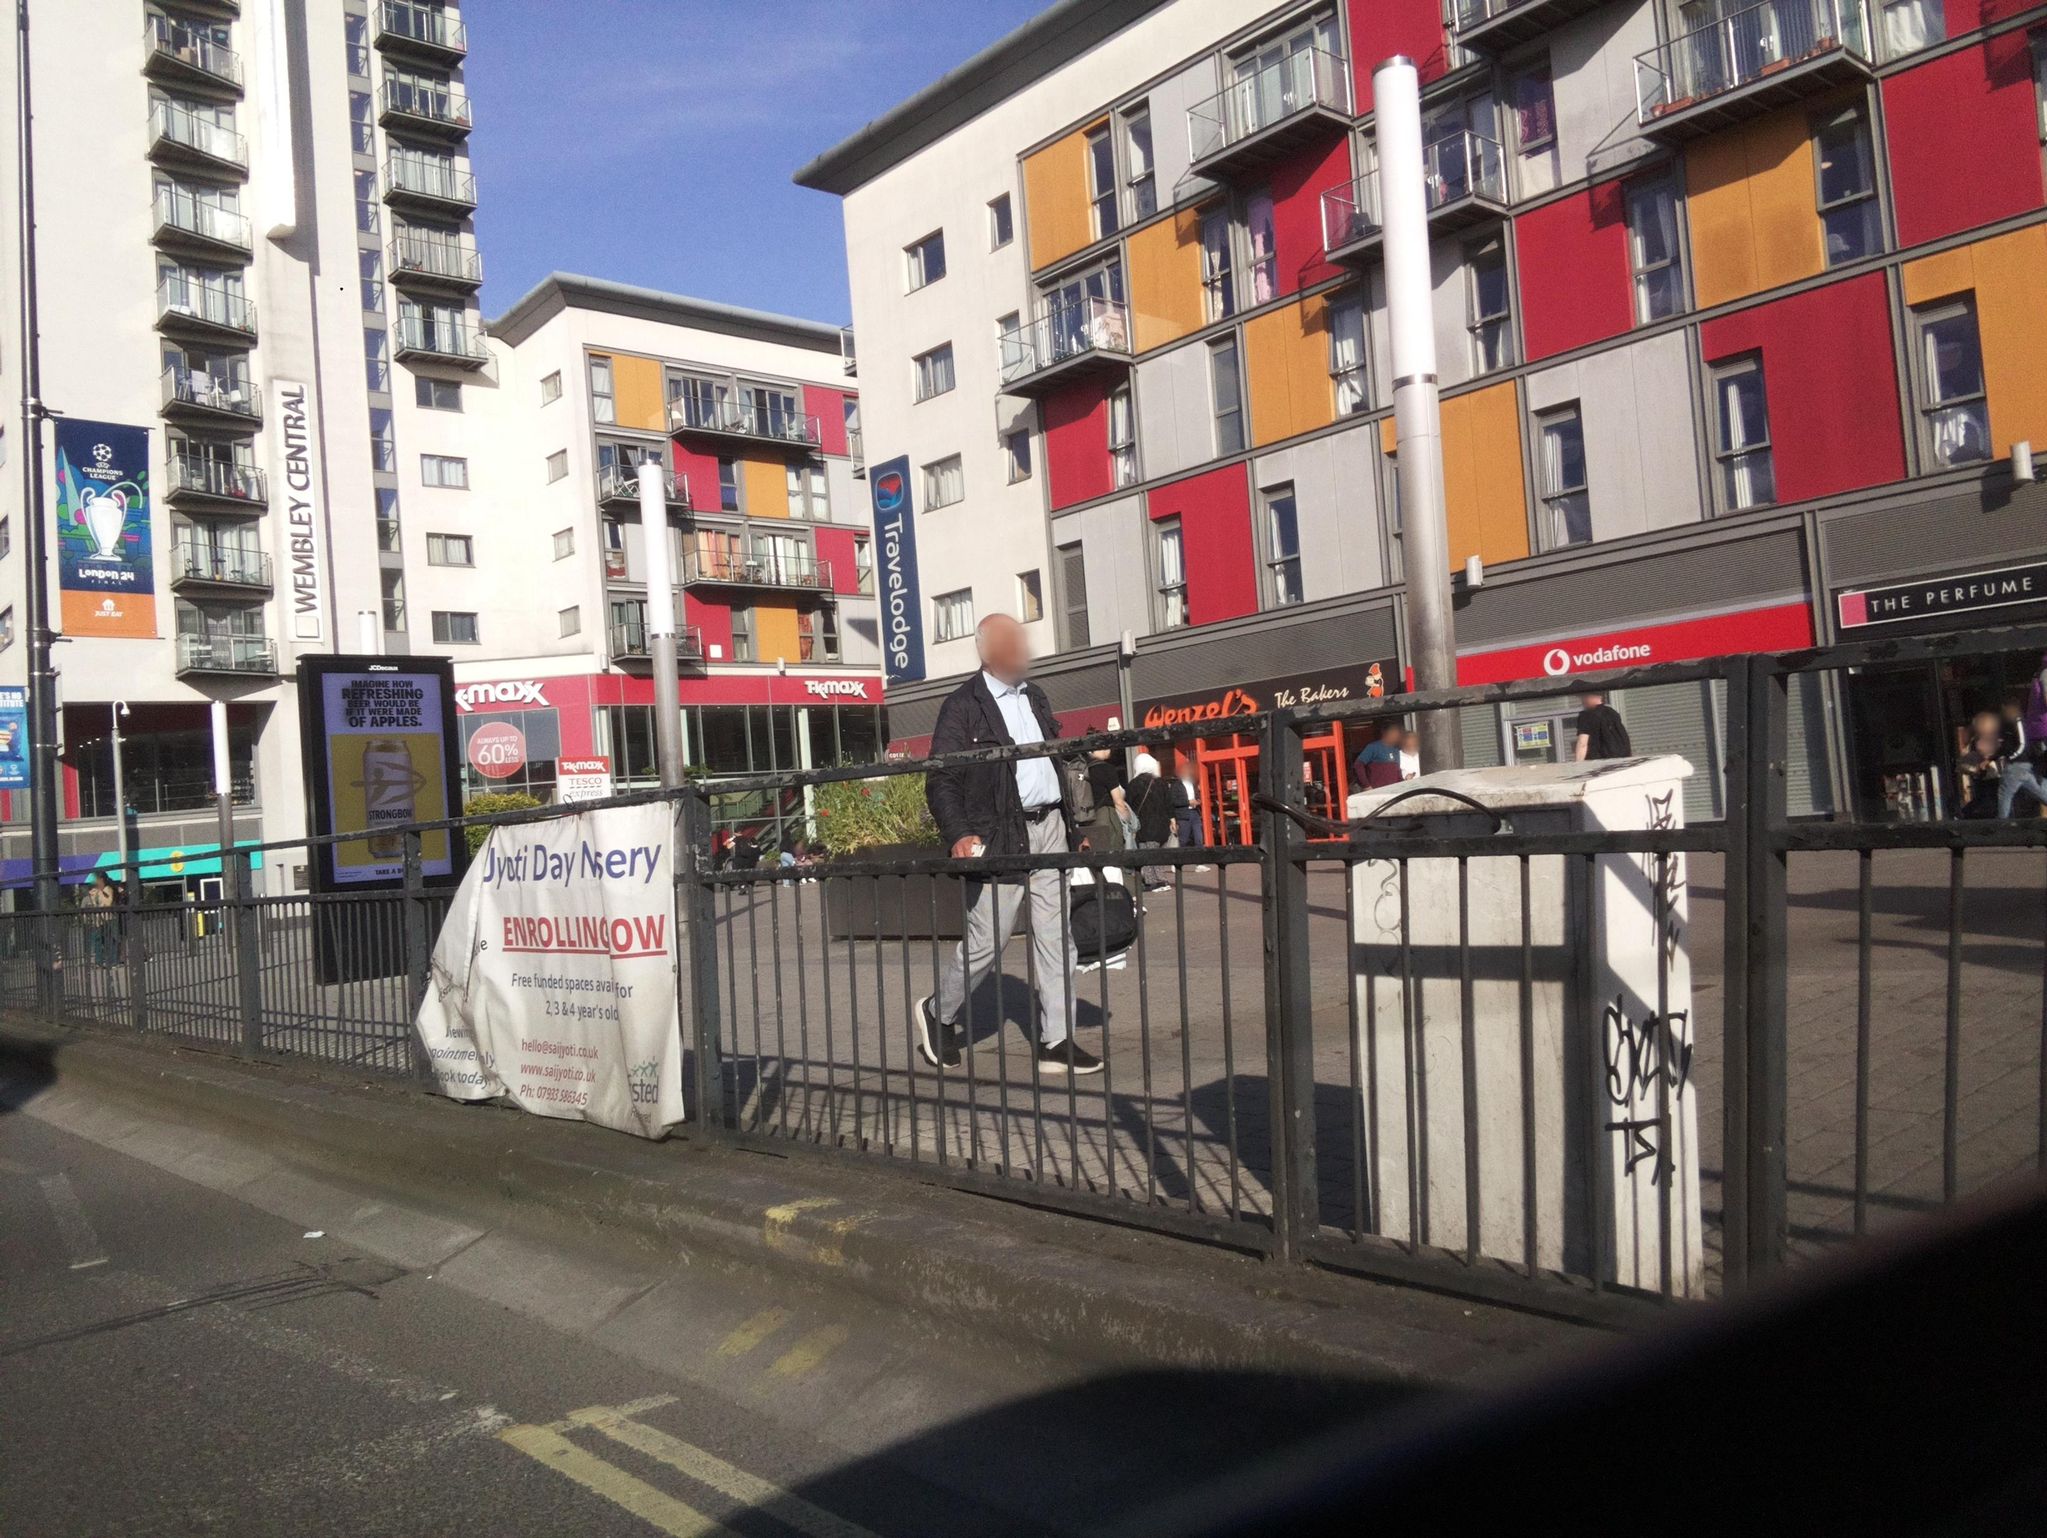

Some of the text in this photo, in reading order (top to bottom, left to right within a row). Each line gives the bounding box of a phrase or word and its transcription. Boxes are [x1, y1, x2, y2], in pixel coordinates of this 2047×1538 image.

[82, 466, 123, 476] CHAMPIONS
[281, 385, 318, 613] WEMBLEY CENTRAL
[120, 571, 135, 581] 24
[884, 513, 911, 669] Travelodge
[1871, 577, 2032, 613] THE PERFUME
[1573, 644, 1651, 666] vodafone
[351, 680, 413, 688] IMAGINE HOW
[342, 688, 424, 699] REFRESHING
[347, 700, 370, 708] BEER
[357, 708, 365, 716] IT
[368, 708, 394, 716] WERE
[1144, 684, 1350, 728] Wenzel's The Bakers
[348, 716, 422, 727] OF APPLES.
[478, 743, 519, 765] 60%
[568, 777, 602, 785] TESCO
[570, 790, 604, 800] express
[483, 845, 528, 890] Jyoti
[533, 844, 576, 887] Day
[610, 914, 665, 952] OW
[511, 973, 532, 987] Free
[533, 973, 563, 989] funded
[565, 978, 594, 994] spaces
[615, 982, 633, 998] for
[555, 1001, 560, 1015] 3
[562, 1002, 568, 1016] &
[569, 1002, 575, 1016] 4
[577, 1004, 603, 1021] year's
[605, 1005, 619, 1020] old
[520, 1084, 535, 1098] Ph:
